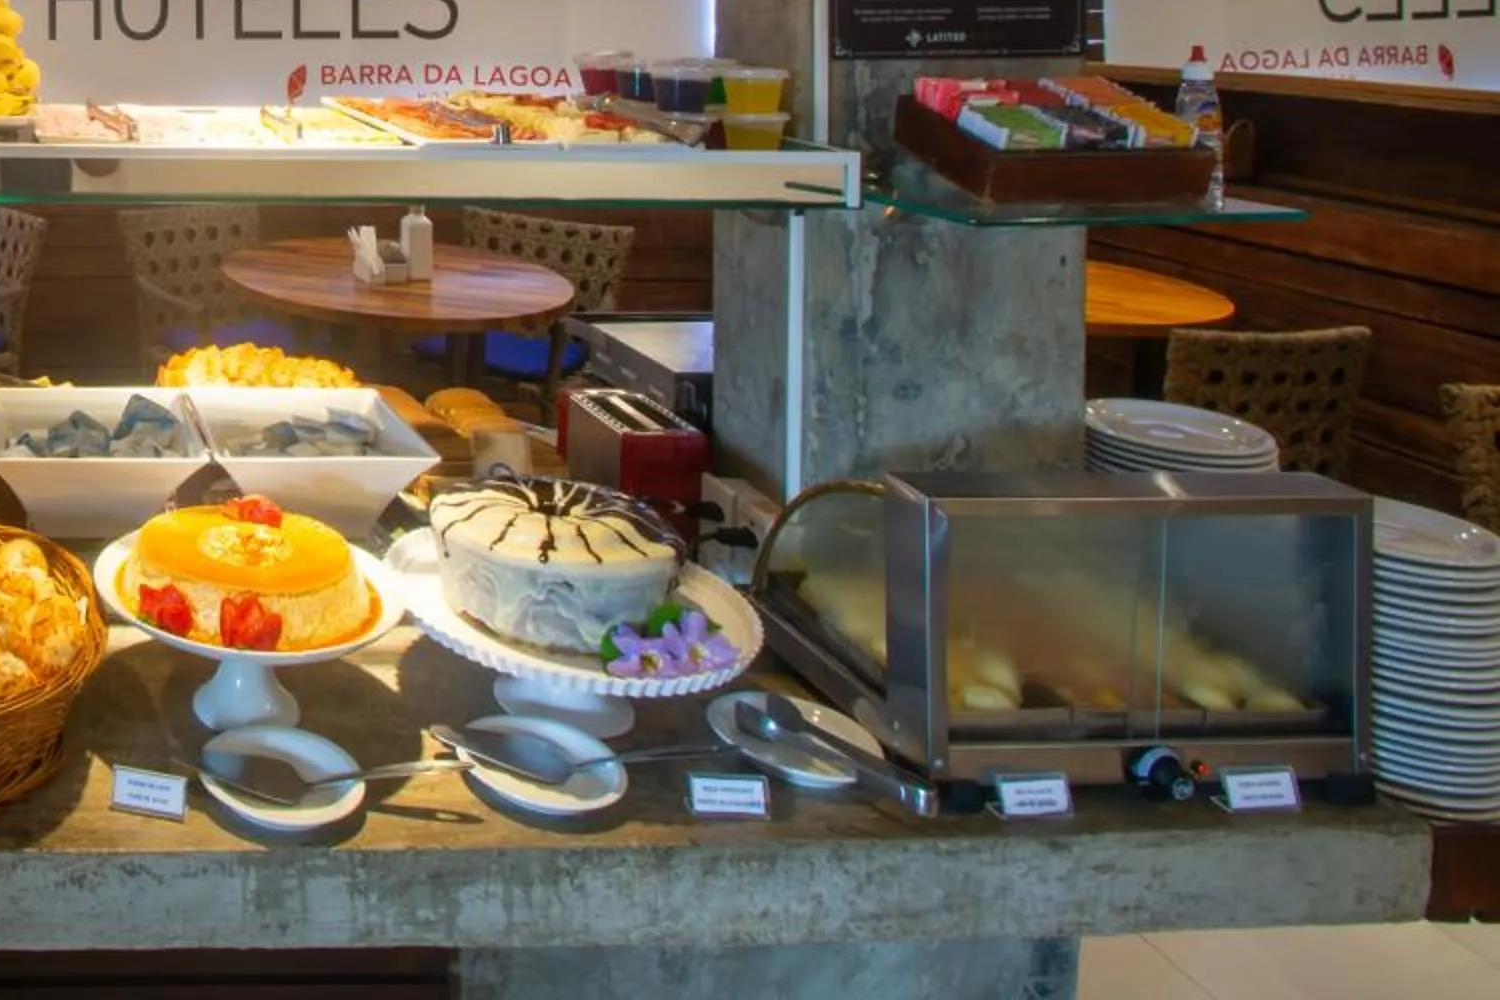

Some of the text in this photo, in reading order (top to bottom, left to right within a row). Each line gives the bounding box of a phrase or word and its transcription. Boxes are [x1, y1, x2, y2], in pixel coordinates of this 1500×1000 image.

[320, 63, 573, 89] BARRA DA LAGOA
